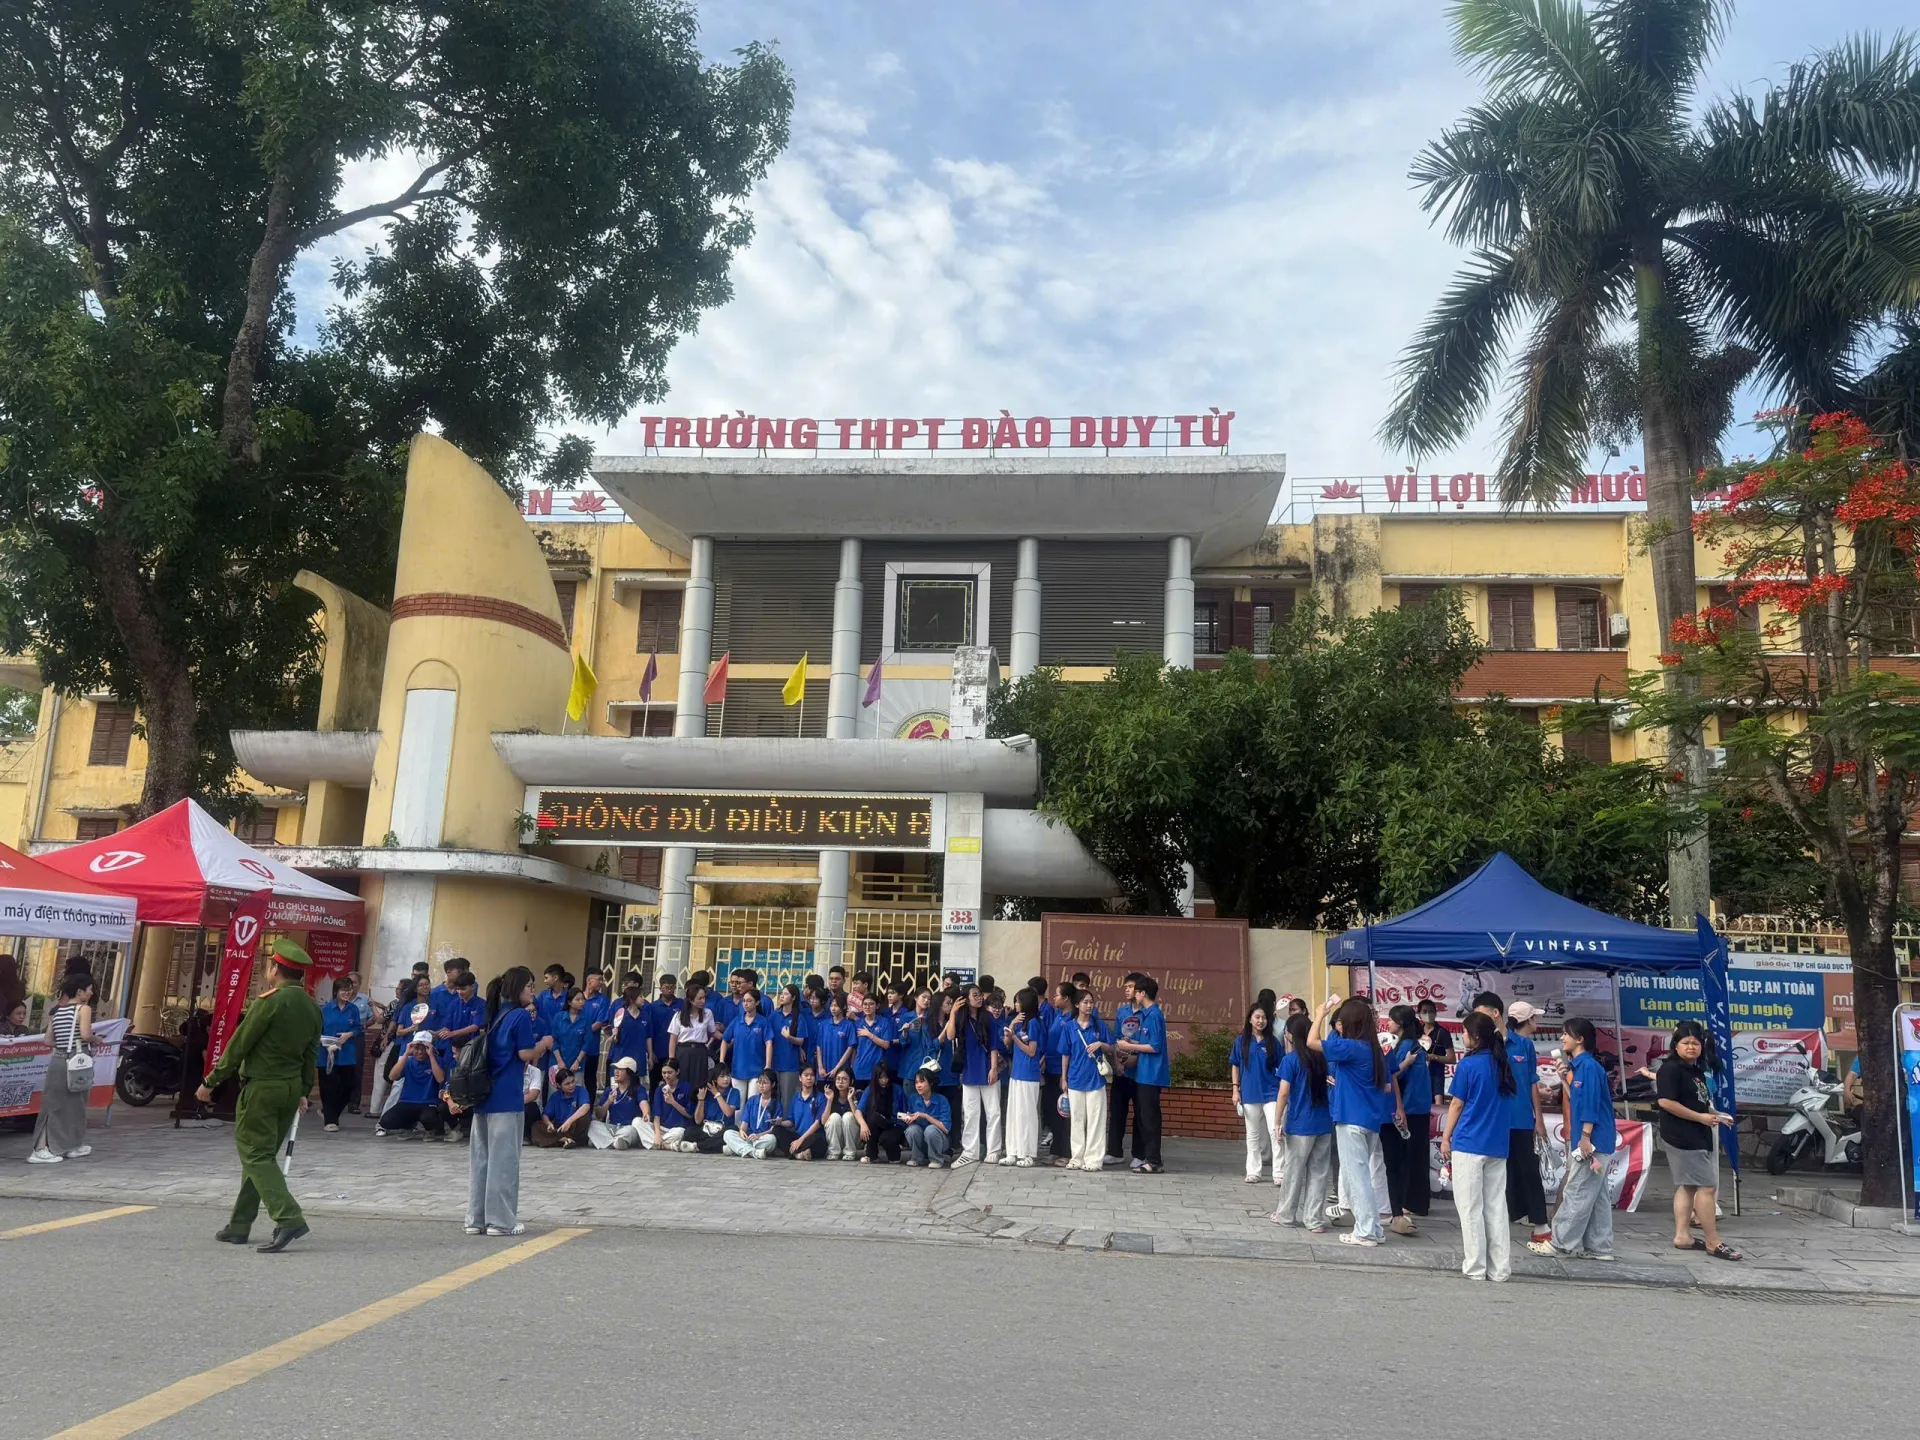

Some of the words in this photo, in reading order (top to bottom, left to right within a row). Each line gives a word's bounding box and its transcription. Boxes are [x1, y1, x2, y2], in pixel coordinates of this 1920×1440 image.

[640, 410, 818, 448] TRƯỜNG
[835, 418, 945, 449] THPT
[961, 409, 1051, 448] ĐÀO
[1070, 416, 1158, 447] DUY
[1174, 407, 1235, 447] TỪ
[1384, 466, 1418, 502] VÌ
[1431, 472, 1486, 509] LỢI
[1571, 466, 1646, 503] MƯỜ
[668, 799, 716, 832] ĐỦ
[726, 797, 807, 834] ĐIỀU
[818, 805, 898, 839] KIỆN
[4, 903, 32, 921] máy
[35, 904, 60, 923] điện
[63, 908, 97, 926] thông
[99, 912, 126, 926] minh
[950, 910, 973, 924] 33
[225, 948, 252, 959] TAIL
[1061, 936, 1099, 961] Tuổi
[1525, 940, 1610, 951] VINFAST
[230, 968, 240, 987] 168
[1164, 970, 1205, 996] luyện
[1618, 972, 1650, 989] CỔNG
[1651, 975, 1700, 990] TRƯỜNG
[1739, 980, 1763, 996] ĐẸP,
[1764, 981, 1780, 994] AN
[1783, 981, 1815, 996] TOÀN
[1403, 979, 1446, 1001] TỐC
[1640, 998, 1672, 1011] Làm
[1675, 998, 1706, 1012] chủ
[1729, 1003, 1749, 1015] ng
[1752, 1003, 1793, 1019] nghệ
[1716, 1002, 1731, 1110] VINFAS
